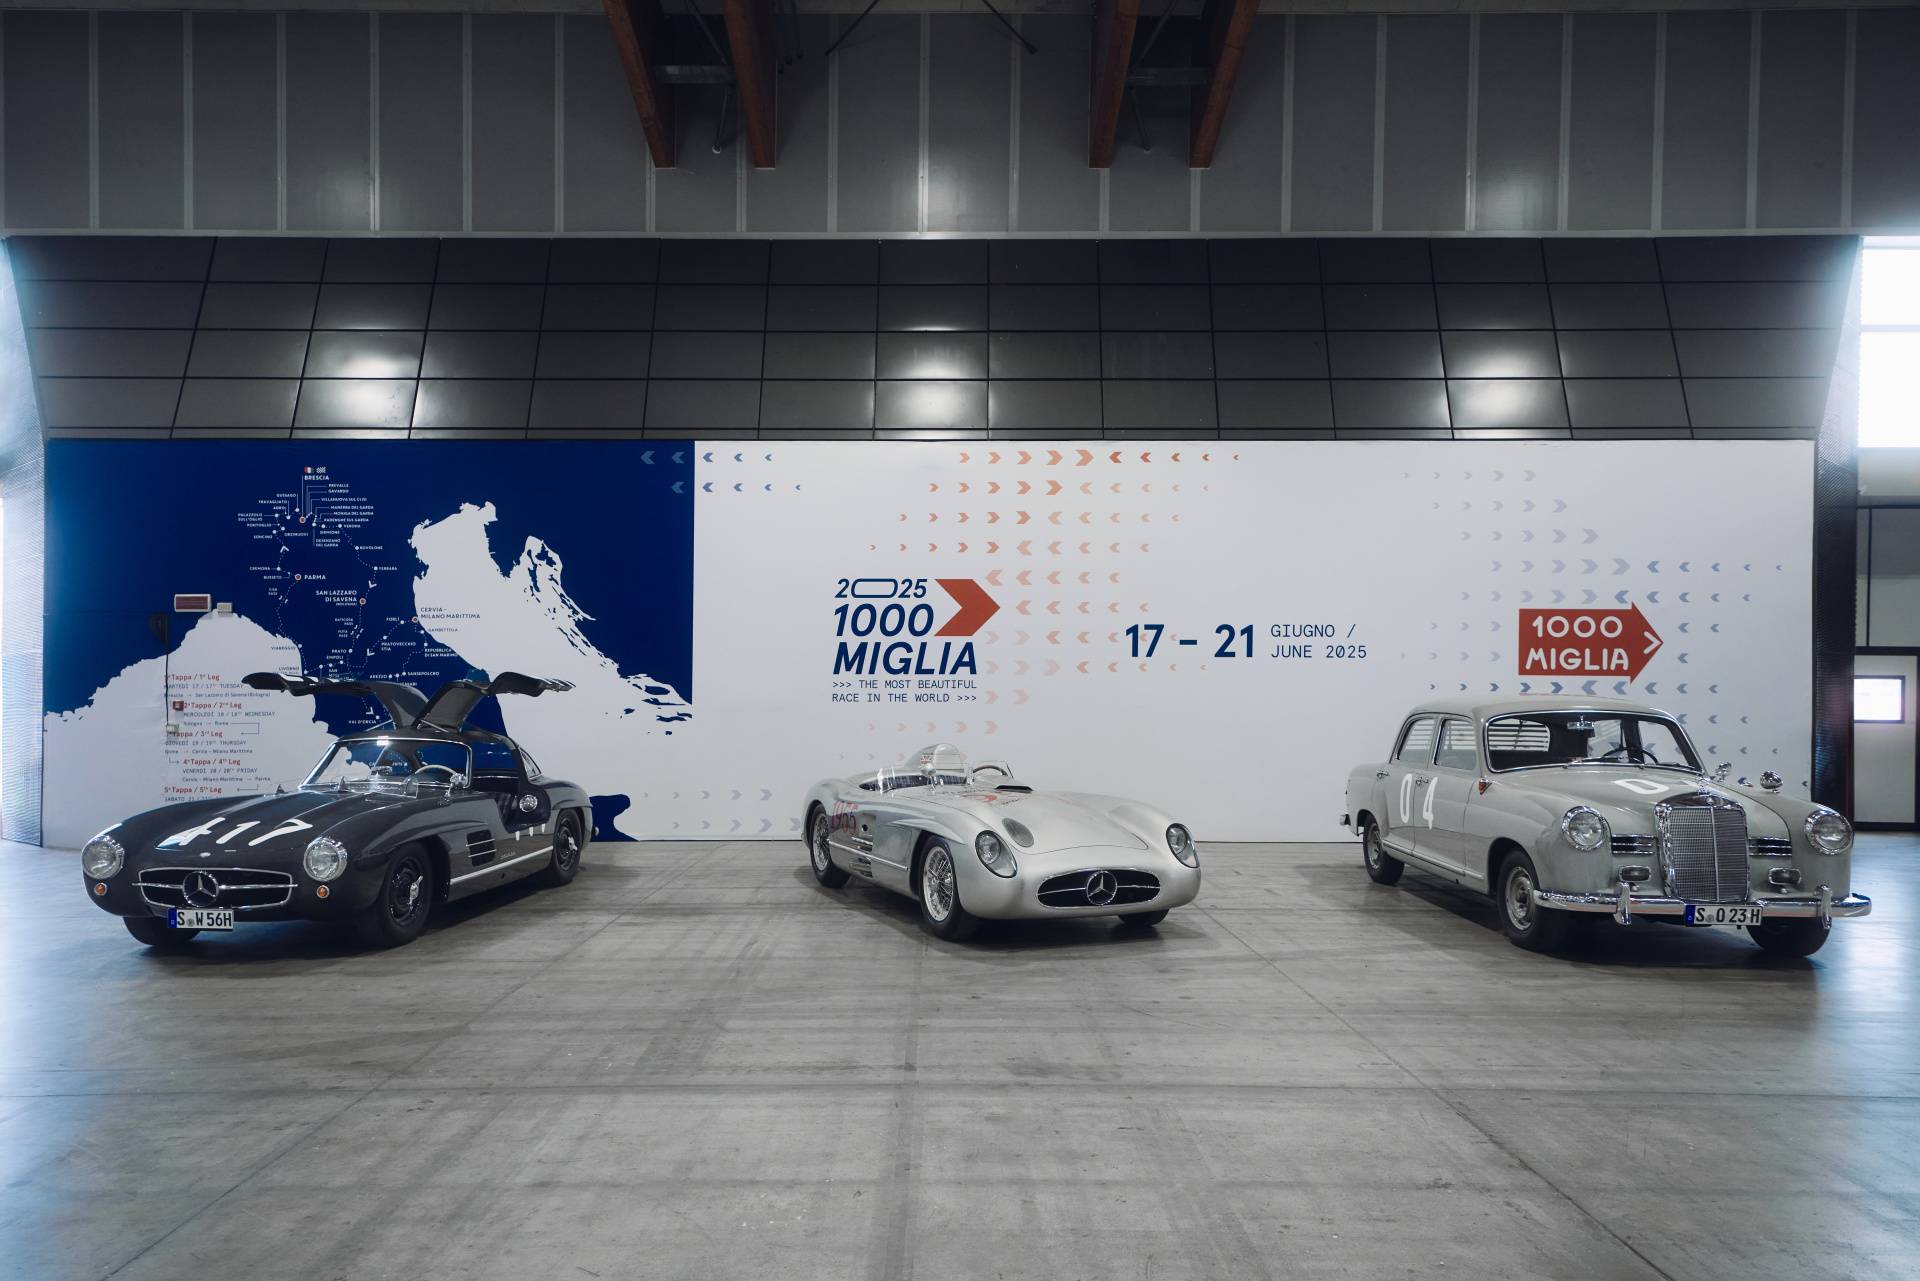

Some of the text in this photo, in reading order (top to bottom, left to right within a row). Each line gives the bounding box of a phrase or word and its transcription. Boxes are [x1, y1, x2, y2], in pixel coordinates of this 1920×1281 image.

[834, 578, 928, 599] 2025
[834, 603, 935, 637] 1000
[1532, 615, 1623, 638] 1000
[1270, 624, 1336, 638] GIUGNO
[1125, 624, 1165, 658] 17
[1214, 624, 1254, 658] 21
[833, 641, 977, 675] MIGLIA
[1271, 645, 1367, 659] JUNE 2025
[1525, 647, 1629, 671] MIGLIA
[859, 680, 878, 689] THE
[884, 680, 912, 689] MOST
[918, 680, 977, 689] BEAUTIFUL
[191, 702, 212, 710] Tappa
[229, 702, 242, 710] Leg
[832, 693, 860, 703] RACE
[868, 693, 881, 703] IN
[888, 693, 908, 703] THE
[915, 693, 950, 703] WORLD
[172, 786, 193, 794] Tappa
[210, 786, 222, 794] Leg
[1400, 773, 1439, 830] 04
[155, 817, 313, 850] 417
[177, 911, 232, 927] S W 56H
[1696, 907, 1706, 922] S
